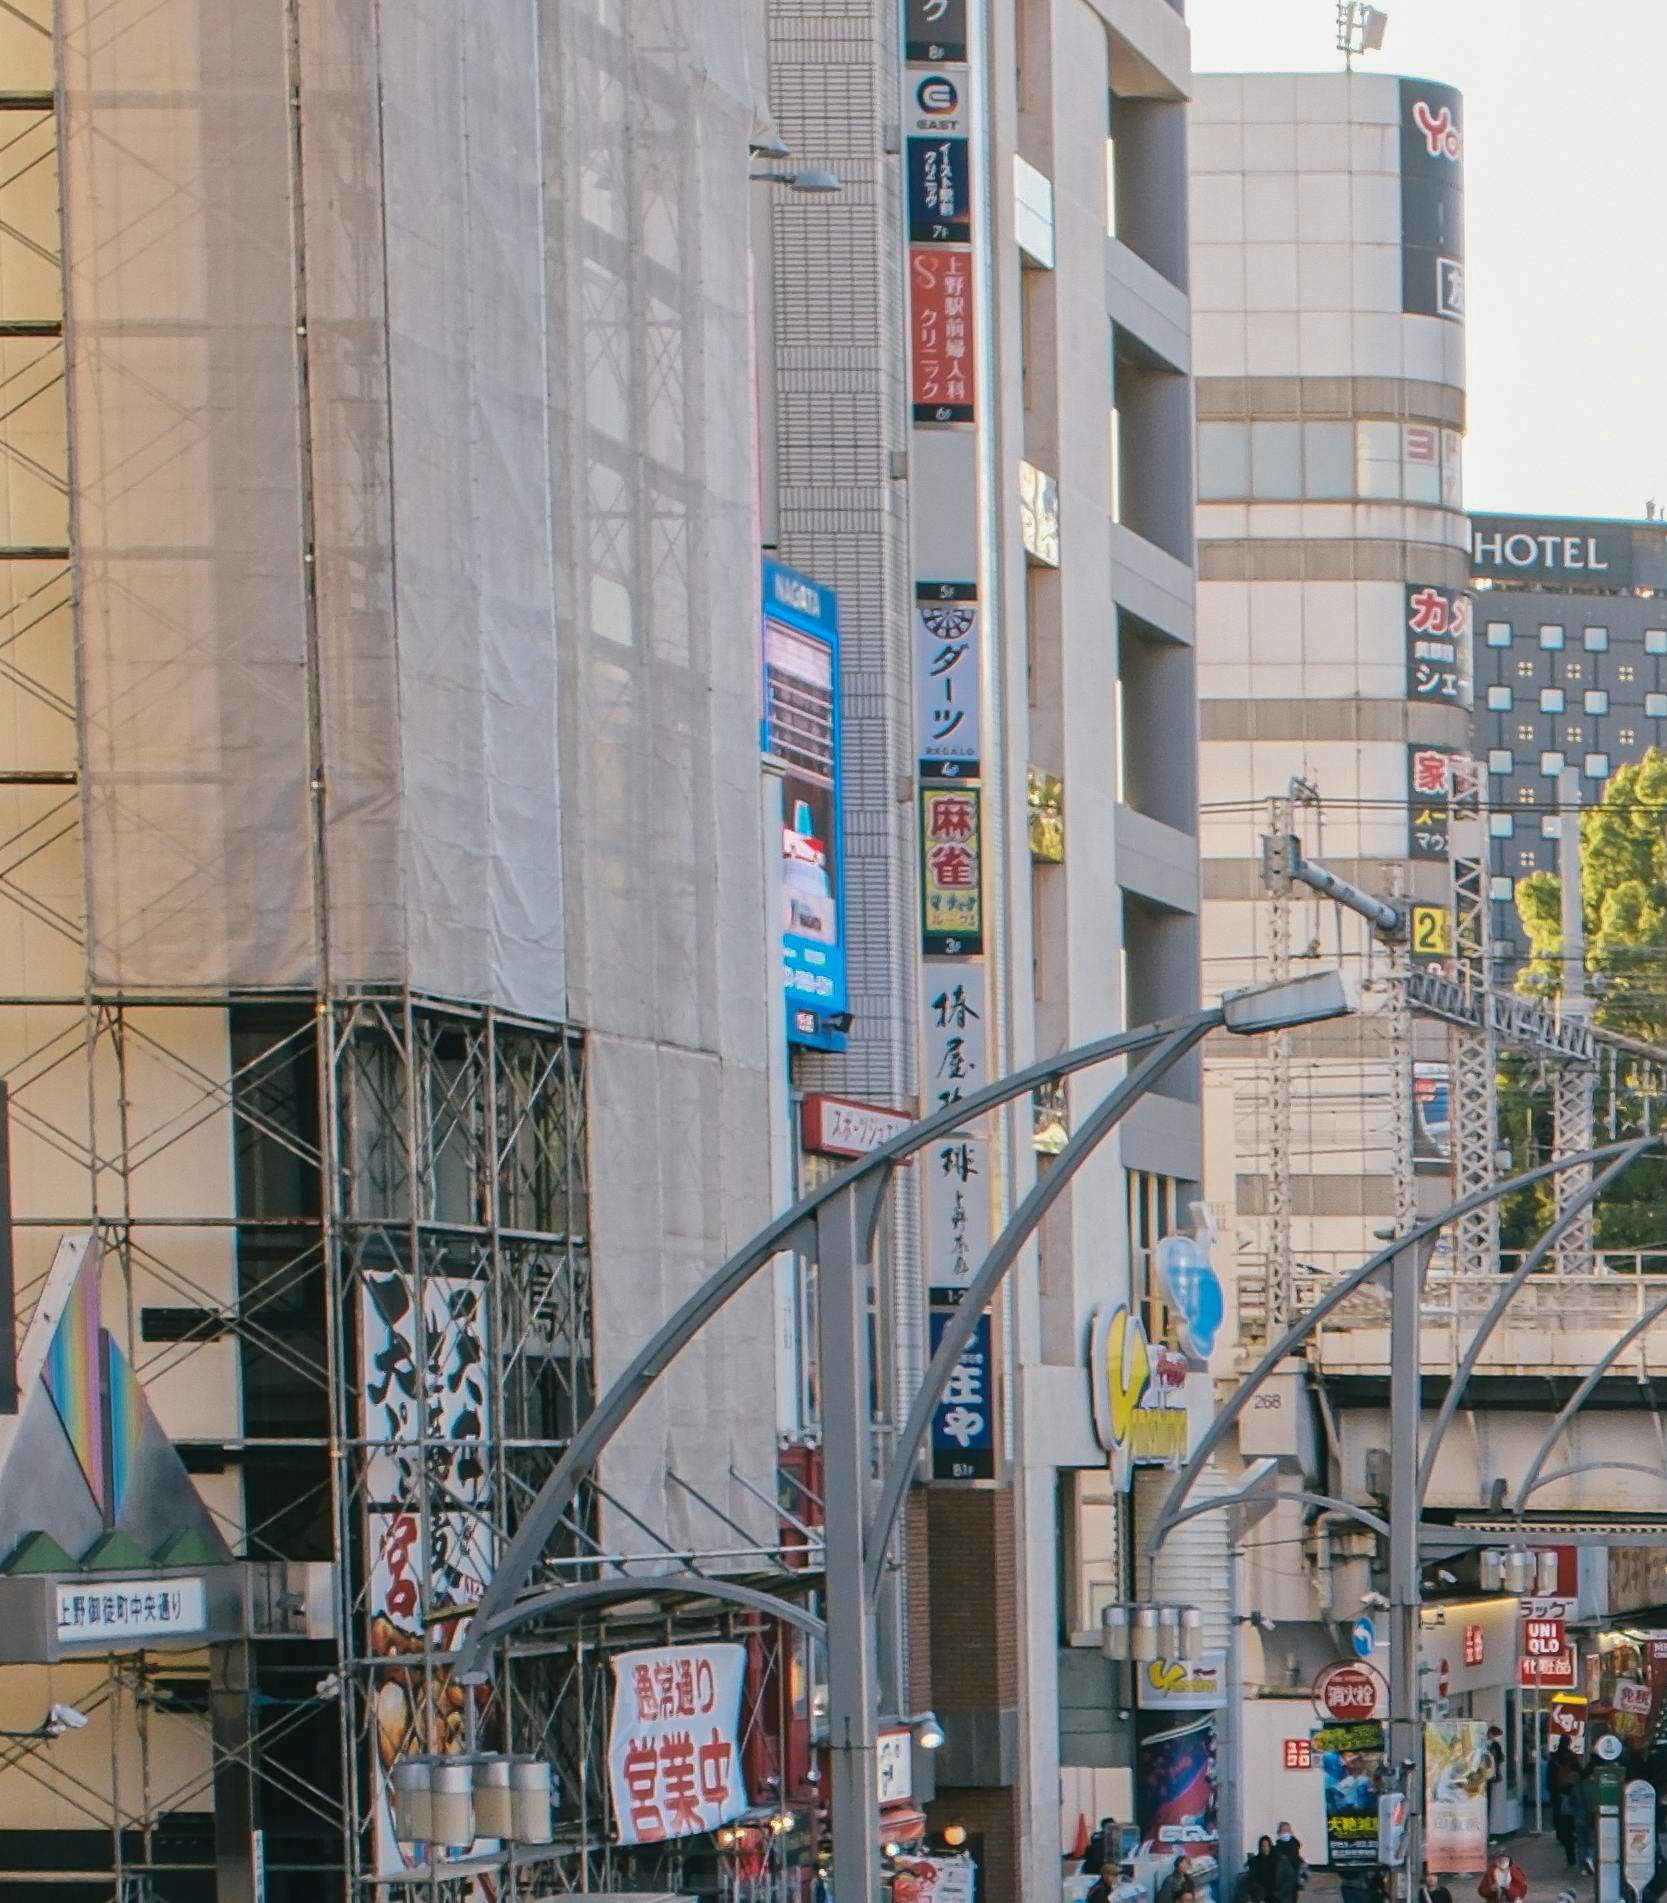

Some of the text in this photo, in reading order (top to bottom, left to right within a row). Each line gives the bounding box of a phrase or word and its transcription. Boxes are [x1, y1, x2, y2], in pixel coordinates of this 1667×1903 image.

[920, 308, 939, 399] クリニック
[944, 257, 966, 399] 上野駅前婦人科
[1474, 530, 1608, 571] HOTEL
[929, 643, 969, 740] ダーツ
[930, 796, 973, 890] 麻雀
[58, 1591, 182, 1627] 上野御徒町中央通り
[1528, 1622, 1557, 1638] UNI
[1529, 1638, 1560, 1654] QLO
[633, 1658, 715, 1722] 通常通り
[1328, 1685, 1374, 1707] 消火栓
[624, 1727, 733, 1844] 営業中
